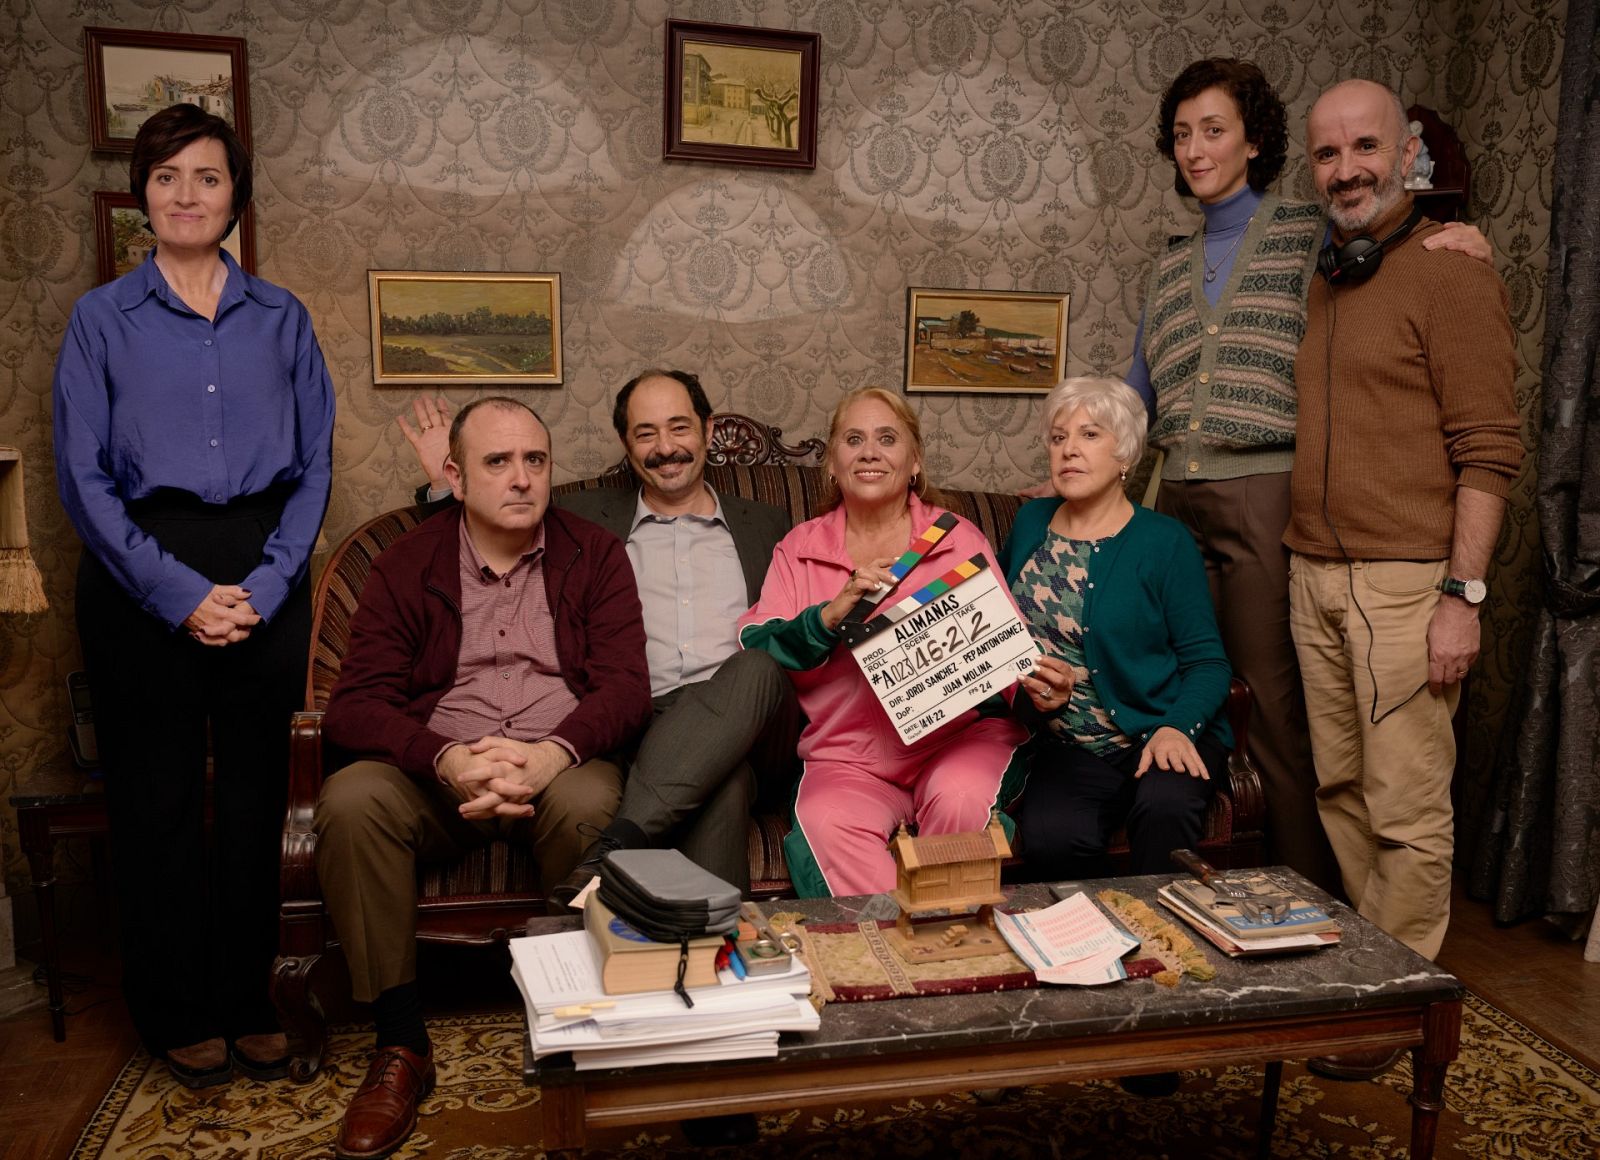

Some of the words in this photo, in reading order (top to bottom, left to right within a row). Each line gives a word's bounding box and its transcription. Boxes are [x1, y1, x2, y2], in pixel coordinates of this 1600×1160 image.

[894, 594, 959, 643] ALIMAÑAS
[956, 603, 976, 618] TAKE
[970, 611, 990, 642] 2
[904, 631, 930, 650] SCENE
[862, 647, 886, 664] PROD.
[1016, 657, 1032, 671] 180
[867, 658, 888, 672] ROLL
[889, 695, 905, 708] DIR:
[905, 682, 926, 701] JORDI
[925, 662, 959, 688] SANCHEZ
[895, 706, 914, 720] DoP:
[942, 677, 963, 696] JUAN
[962, 660, 992, 684] MOLINA
[968, 686, 979, 695] FPS
[979, 680, 992, 694] 24
